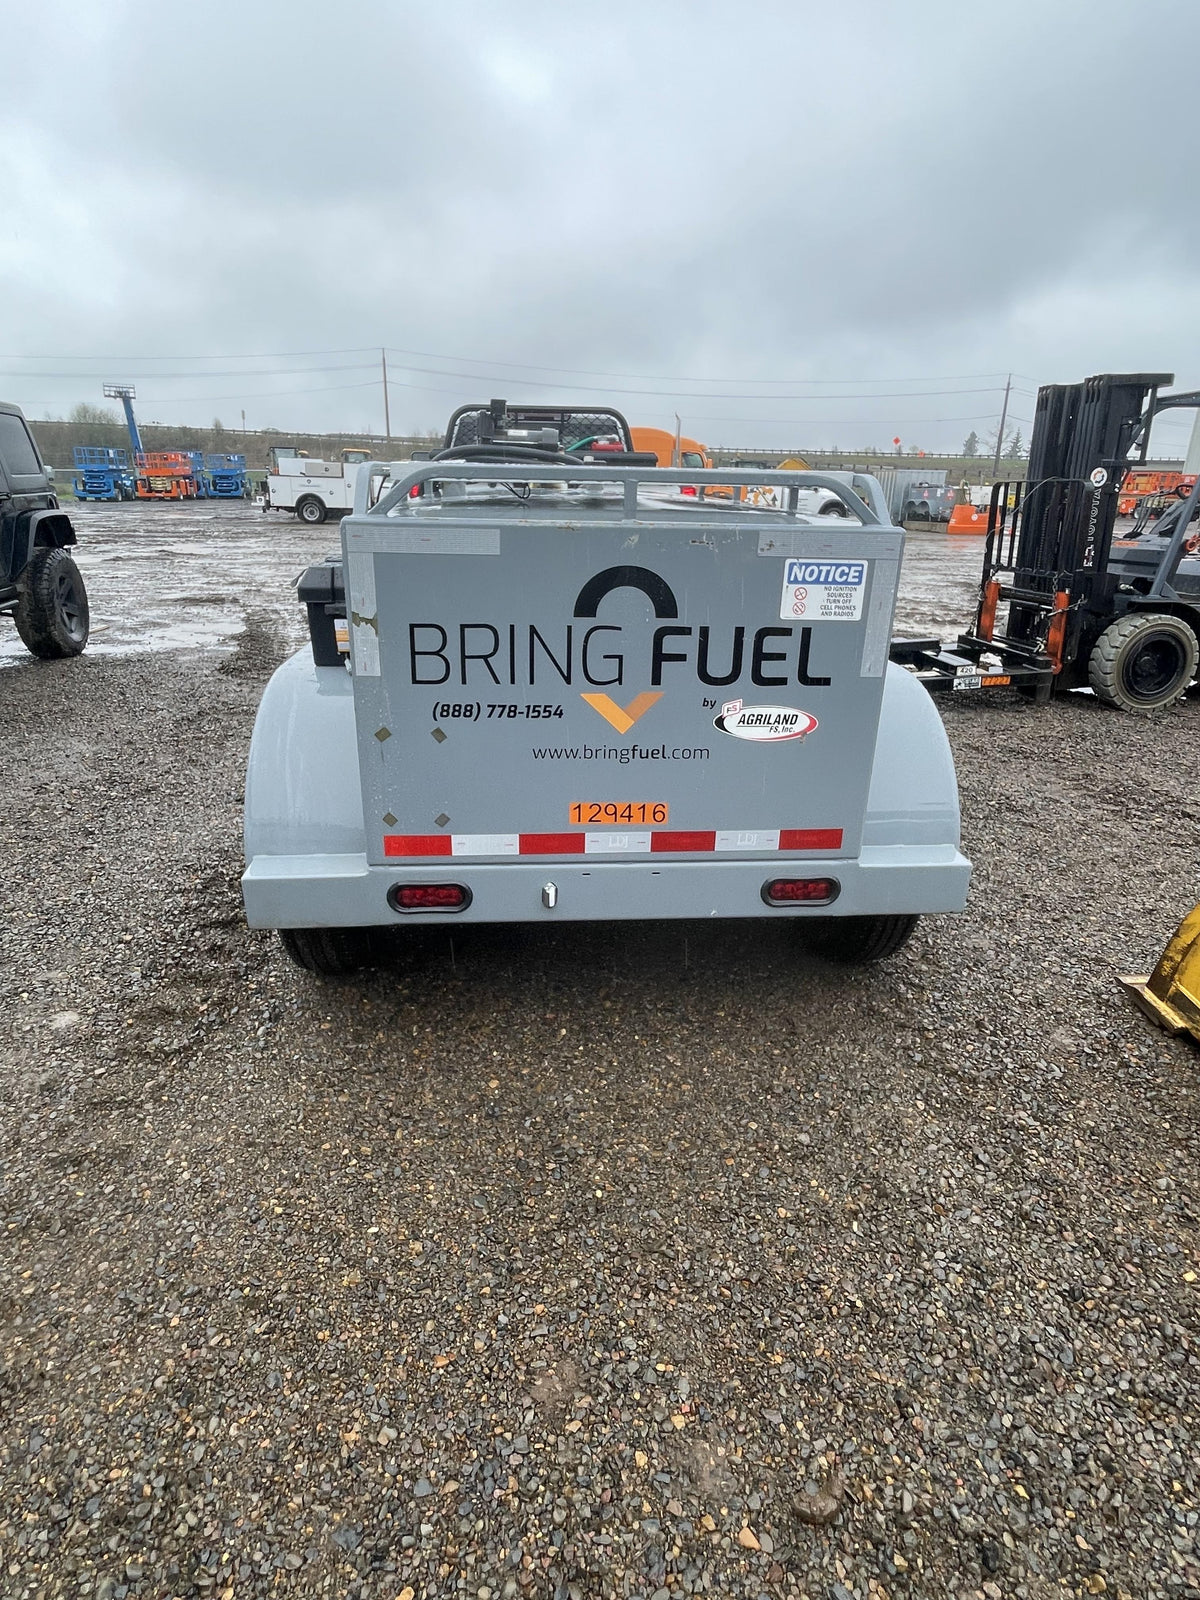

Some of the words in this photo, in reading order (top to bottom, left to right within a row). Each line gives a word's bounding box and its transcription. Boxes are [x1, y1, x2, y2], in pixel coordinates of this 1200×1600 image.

[1087, 488, 1102, 542] TOYOTA
[789, 565, 863, 583] NOTICE
[408, 622, 625, 687] BRING
[650, 625, 832, 687] FUEL
[432, 701, 482, 722] (888)
[486, 704, 564, 719] 778-1554
[702, 698, 717, 710] by
[726, 704, 738, 714] FS
[737, 713, 799, 726] AGRILAND
[781, 725, 796, 733] Inc.
[532, 744, 711, 764] www.bringfuel.com
[572, 803, 667, 823] 129416
